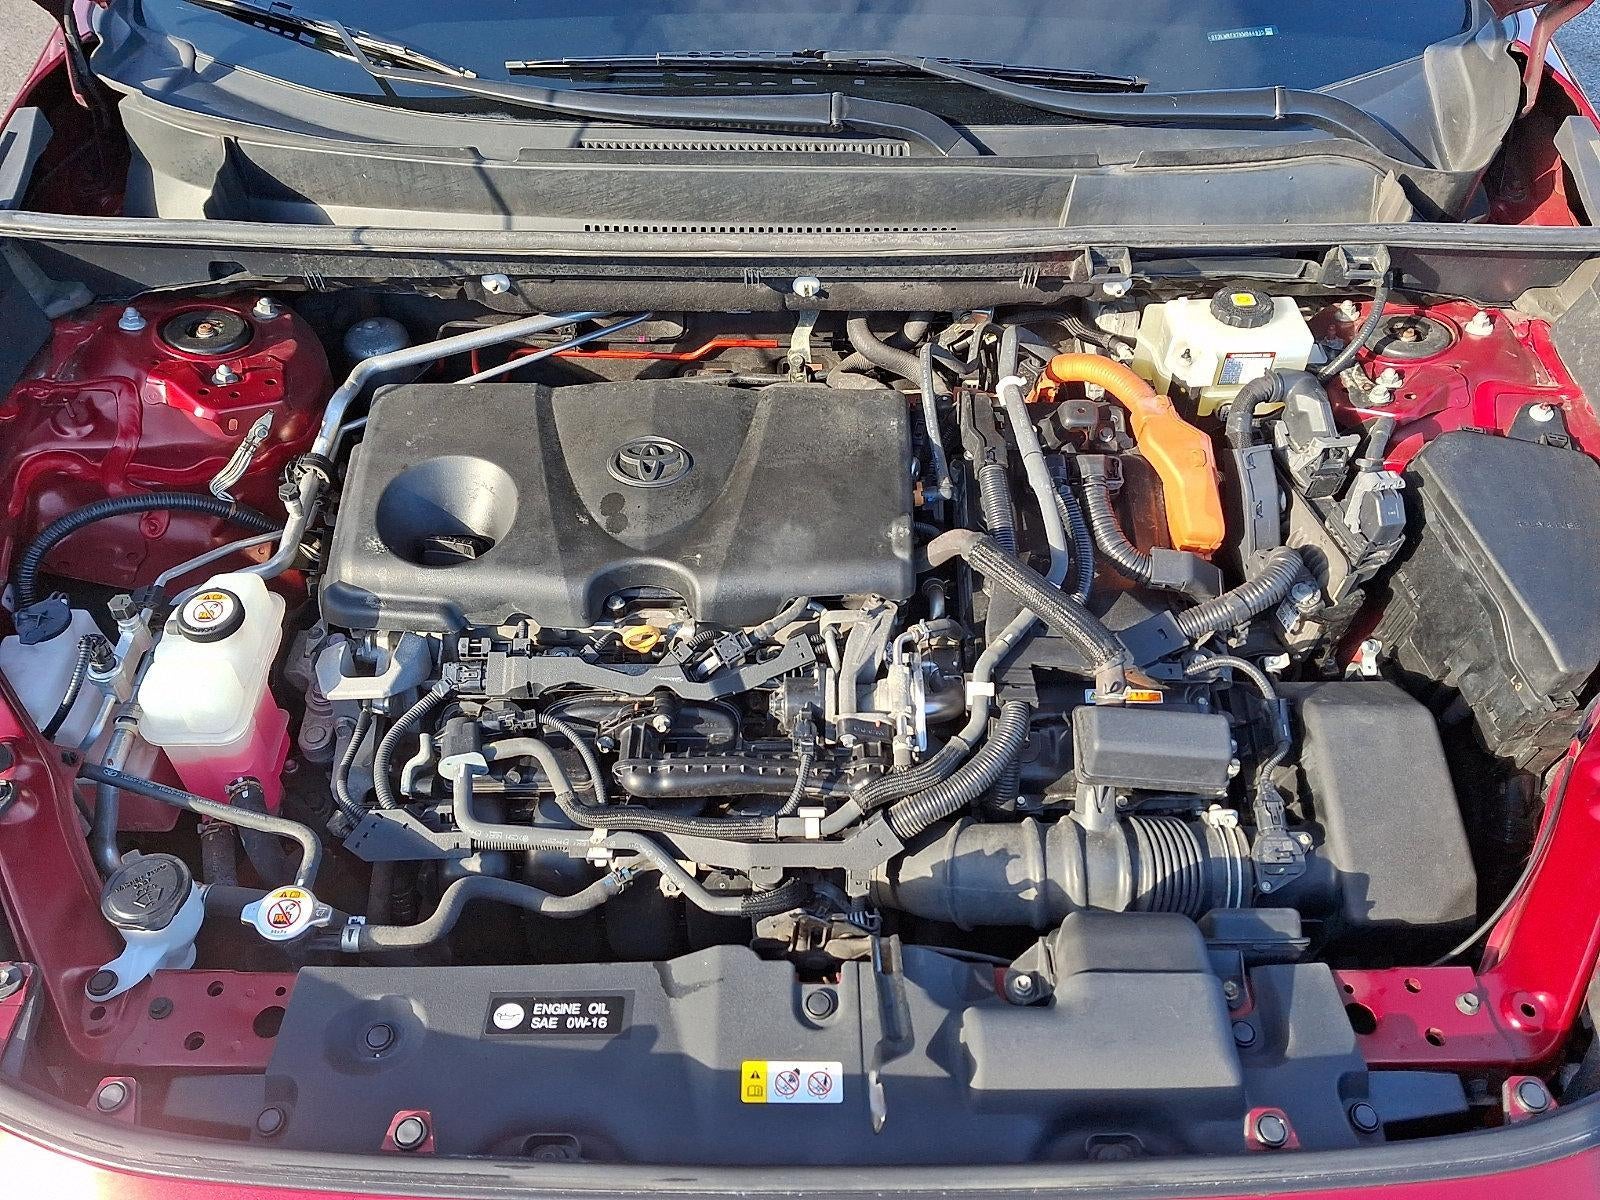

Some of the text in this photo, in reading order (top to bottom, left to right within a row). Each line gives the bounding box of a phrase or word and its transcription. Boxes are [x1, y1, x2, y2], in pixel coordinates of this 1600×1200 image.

[533, 1003, 609, 1015] ENGINE OIL
[530, 1017, 608, 1029] SAE 0W-16
